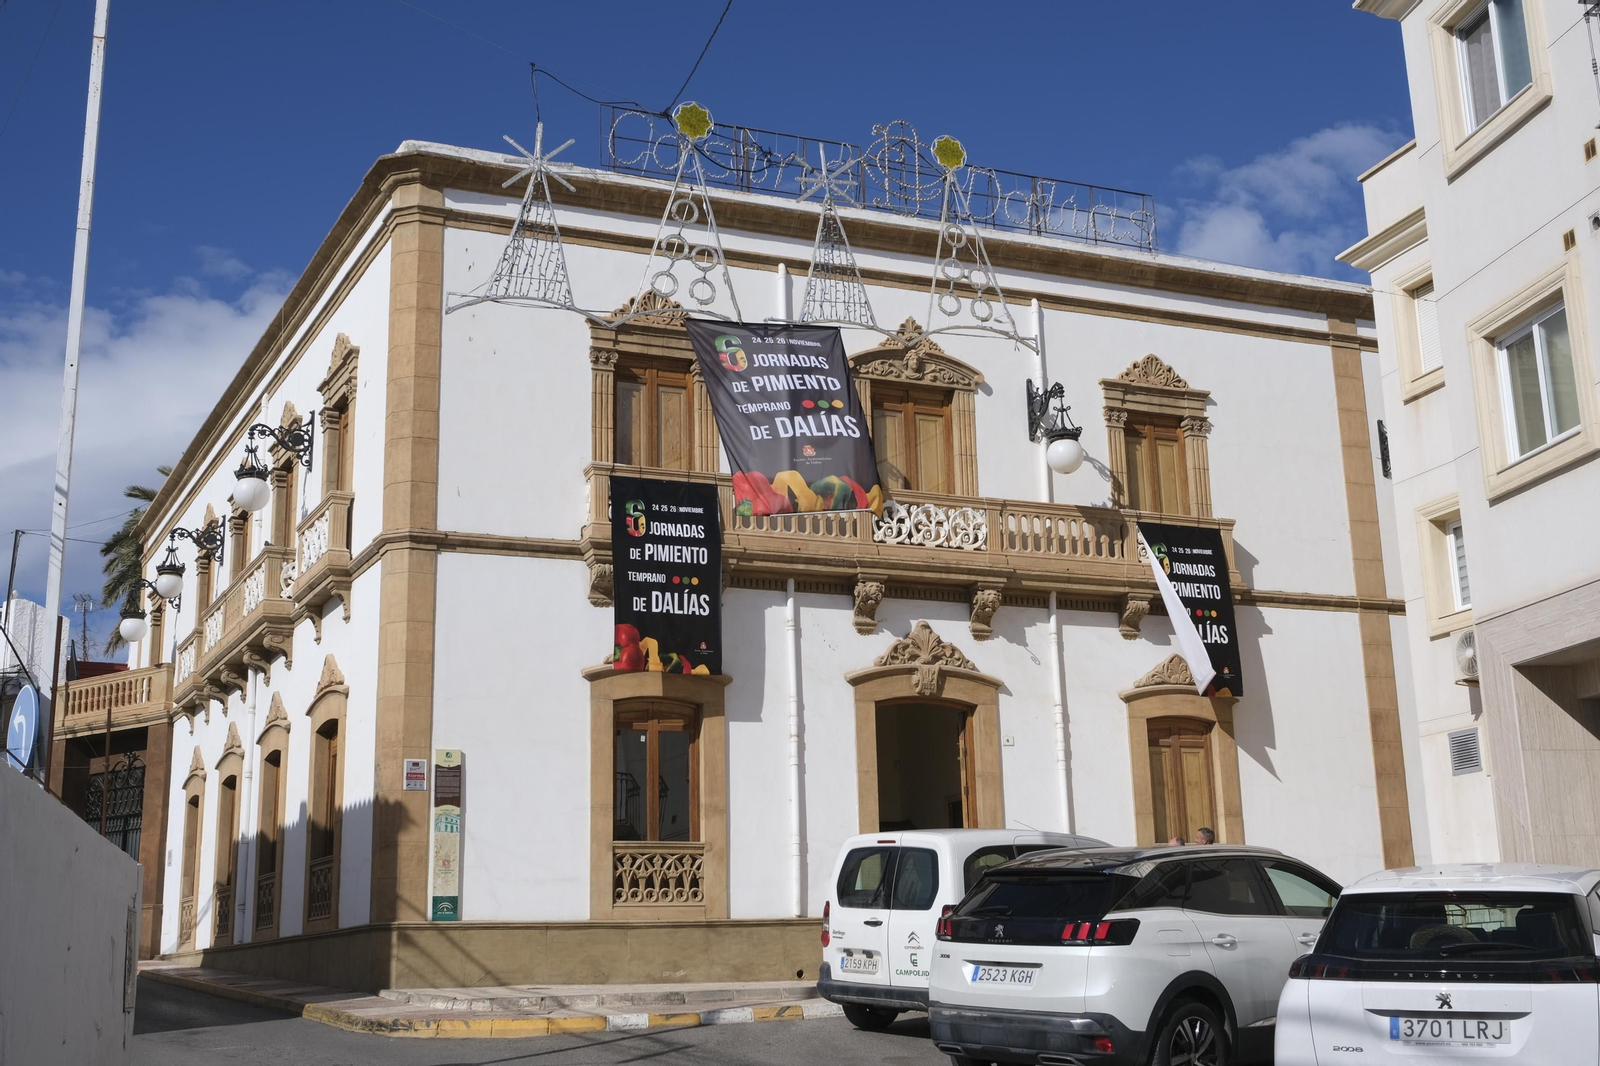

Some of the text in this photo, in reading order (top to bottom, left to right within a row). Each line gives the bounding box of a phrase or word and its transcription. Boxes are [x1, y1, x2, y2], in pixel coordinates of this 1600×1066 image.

[789, 338, 822, 347] NOVIEMBRE
[714, 335, 748, 372] 6
[752, 354, 829, 369] JORNADAS
[732, 374, 841, 393] DE PIMIENTO
[736, 401, 791, 414] TEMPRANO
[750, 411, 860, 440] DE DALÍAS
[626, 499, 646, 537] 6
[649, 521, 704, 538] JORNADAS
[630, 543, 707, 564] DE PIMIENTO
[628, 571, 666, 583] TEMPRANO
[1172, 562, 1215, 577] JORNADAS
[1171, 582, 1221, 599] PIMIENTO
[633, 589, 709, 616] DE DALÍAS
[1199, 621, 1228, 644] LÍAS
[845, 958, 877, 970] 2159 KPH
[979, 968, 1033, 983] 2523 KGH
[1403, 1019, 1453, 1038] 3701
[1463, 1021, 1503, 1040] LRJ
